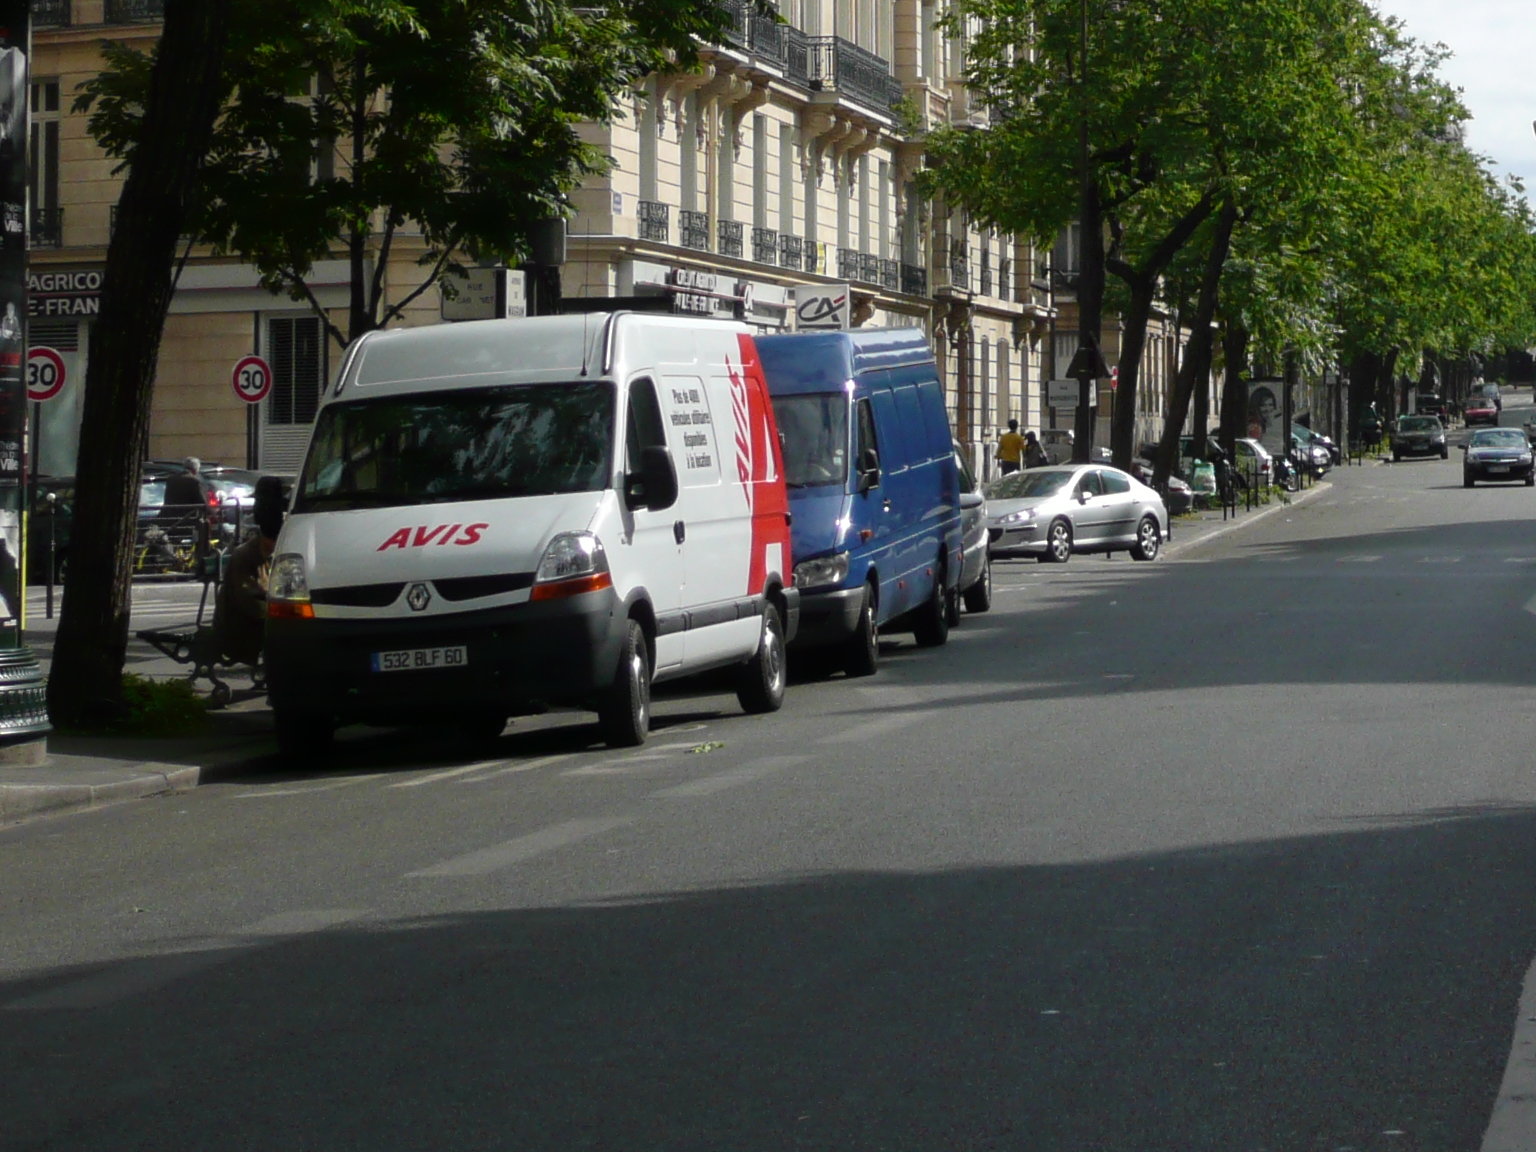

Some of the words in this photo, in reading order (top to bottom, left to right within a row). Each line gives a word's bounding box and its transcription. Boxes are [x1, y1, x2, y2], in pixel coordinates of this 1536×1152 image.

[28, 272, 104, 290] AGRICO
[239, 368, 264, 390] 30
[376, 523, 489, 552] AVIS
[384, 652, 410, 669] 532
[444, 649, 462, 664] 60
